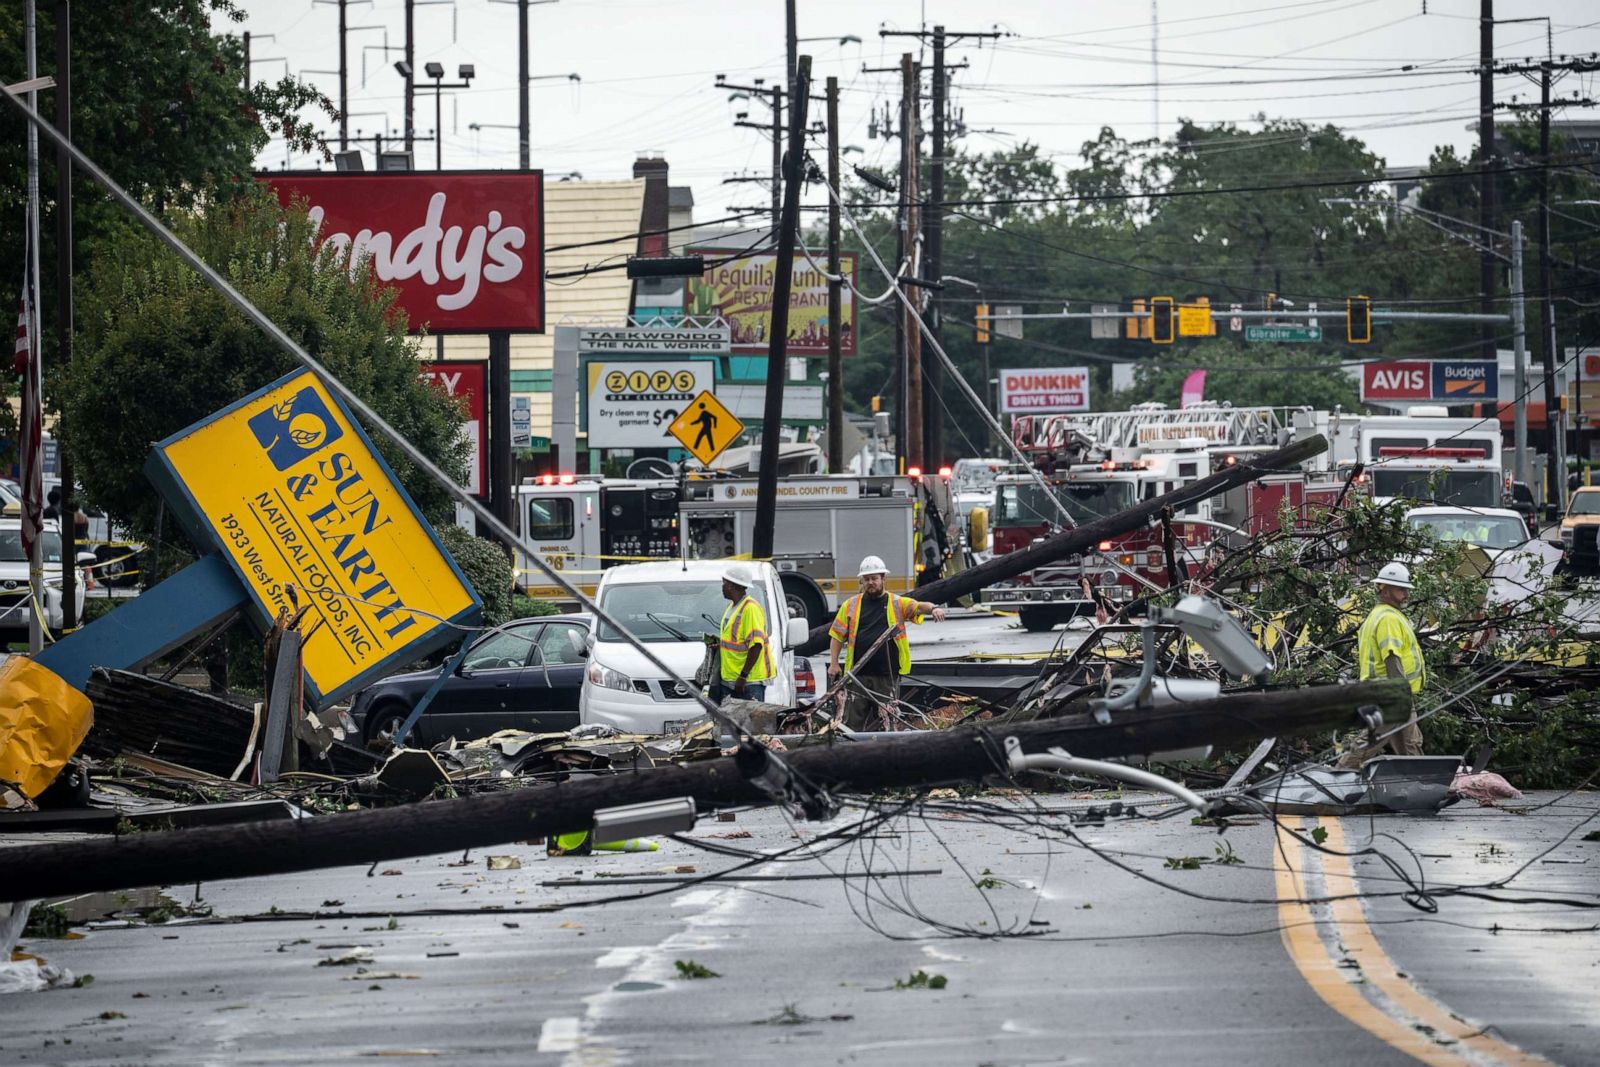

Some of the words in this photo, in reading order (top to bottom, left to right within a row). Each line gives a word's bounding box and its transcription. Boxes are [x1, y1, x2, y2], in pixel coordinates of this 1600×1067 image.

[307, 192, 525, 310] endy's
[588, 332, 722, 340] TAEKWONDO
[588, 341, 618, 349] THE
[664, 342, 721, 350] WORKS
[609, 373, 691, 390] ZIPS
[1371, 370, 1424, 390] AVIS
[1445, 366, 1486, 380] Budget
[1006, 373, 1086, 391] DUNKIN'
[1012, 395, 1047, 406] DRIVE
[1048, 394, 1079, 404] THRU
[600, 409, 613, 418] Dry
[615, 408, 634, 417] clean
[619, 419, 650, 428] garment
[318, 452, 393, 536] SUN
[799, 486, 830, 496] COUNTY
[831, 486, 849, 495] FIRE
[220, 513, 250, 549] 1933
[243, 547, 274, 585] West
[286, 473, 318, 501] &
[307, 499, 417, 640] EARTH
[255, 492, 309, 565] NATURAL
[303, 563, 348, 627] FOODS,
[343, 624, 371, 660] INC.
